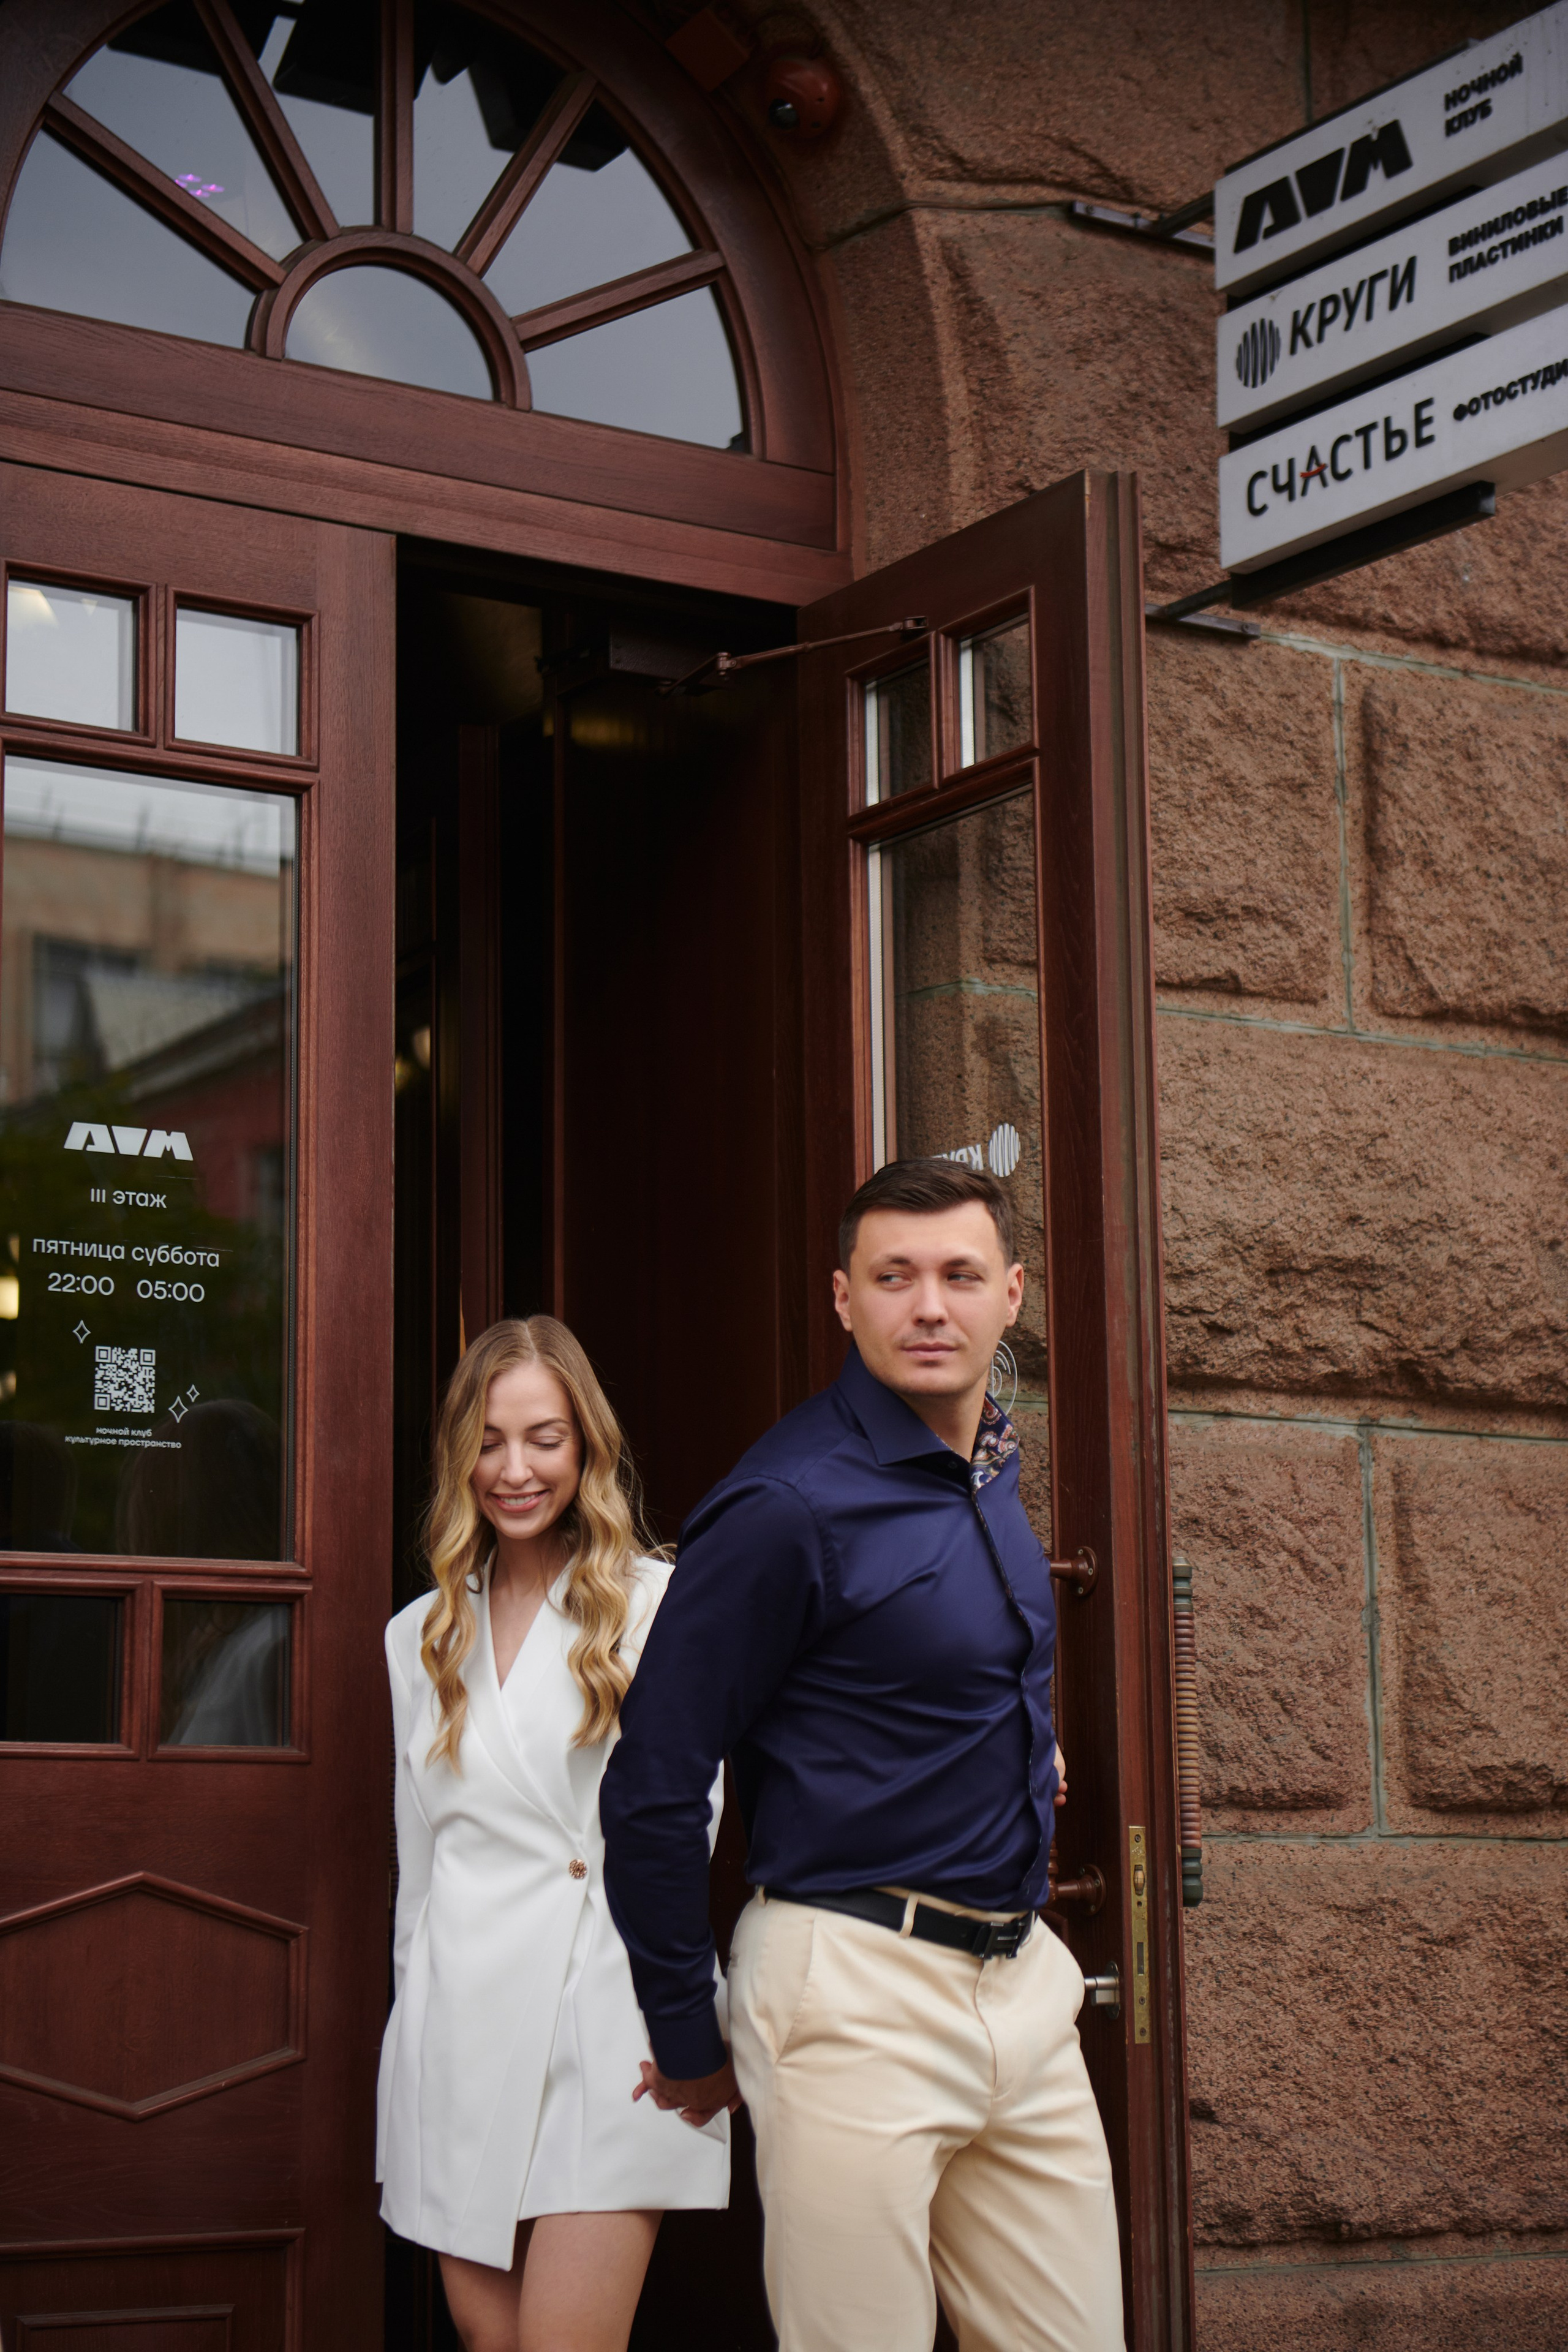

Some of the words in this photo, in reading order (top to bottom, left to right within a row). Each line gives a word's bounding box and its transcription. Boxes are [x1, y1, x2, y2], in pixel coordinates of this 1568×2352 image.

[1444, 50, 1523, 111] НОЧНОЙ
[1445, 98, 1493, 137] КЛУБ
[1448, 186, 1568, 257] ВИНИЛОВЫЕ
[1449, 216, 1564, 283] ПЛАСТИНКИ
[1289, 255, 1417, 355] КРУГИ
[1247, 397, 1436, 516] СЧАСТЬЕ
[112, 1190, 167, 1208] этаж
[33, 1238, 125, 1261] пятница
[131, 1245, 219, 1267] суббота
[47, 1272, 115, 1295] 22:00
[137, 1279, 205, 1302] 05:00
[64, 1435, 117, 1446] культурное
[118, 1438, 182, 1449] пространство
[96, 1427, 129, 1436] ночной
[130, 1428, 153, 1438] клуб
